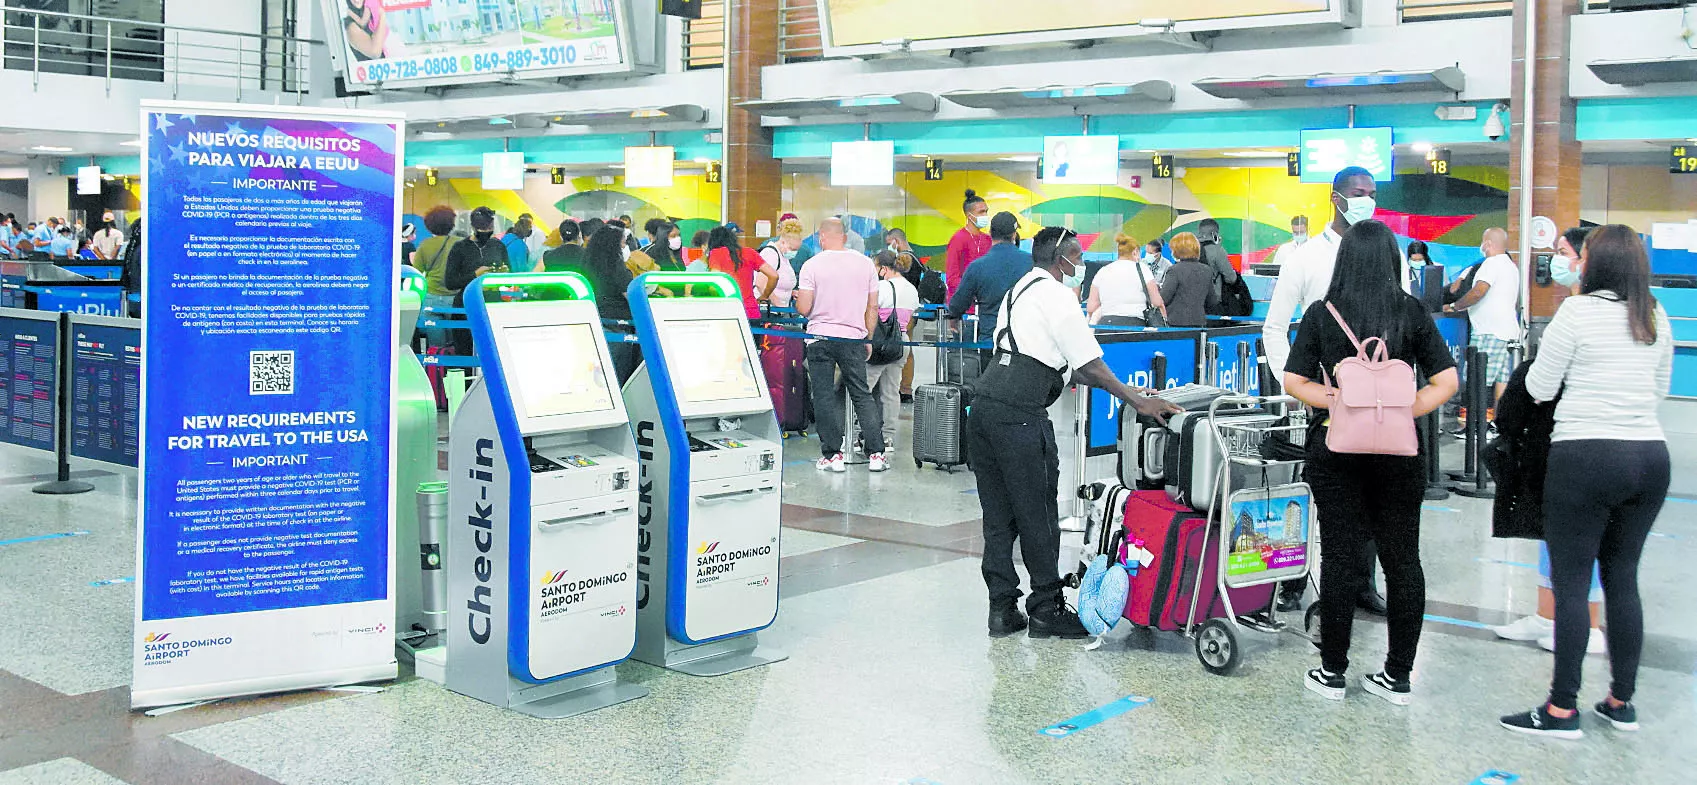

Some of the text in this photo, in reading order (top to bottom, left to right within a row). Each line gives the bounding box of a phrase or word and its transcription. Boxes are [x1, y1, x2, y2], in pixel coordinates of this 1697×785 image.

[368, 45, 576, 81] 809-728-0808 849-889-3010
[188, 132, 361, 152] NUEVOS REQUISITOS
[188, 151, 360, 171] PARA VIAJAR A EEUU
[1431, 160, 1447, 174] 18
[1679, 157, 1697, 172] 19
[929, 168, 940, 179] 14
[1157, 165, 1170, 177] 16
[1293, 163, 1299, 175] 1
[554, 174, 562, 184] 10
[709, 172, 719, 182] 12
[233, 178, 317, 191] IMPORTANTE
[183, 411, 356, 430] NEW REQUIREMENTS
[168, 430, 369, 450] FOR TRAVEL TO THE USA
[232, 454, 308, 468] IMPORTANT
[186, 478, 222, 486] passengers
[237, 483, 261, 491] provide
[266, 481, 294, 489] negative
[175, 494, 206, 502] antigens)
[205, 492, 239, 500] performed
[261, 511, 294, 519] laboratory
[188, 539, 221, 547] passenger
[249, 535, 272, 543] provide
[273, 533, 300, 541] negative
[312, 529, 359, 537] documentation
[467, 437, 494, 645] Check-in
[697, 553, 728, 567] SANTO
[215, 589, 244, 597] available
[243, 588, 253, 596] by
[252, 586, 281, 595] scanning
[293, 584, 304, 592] QR
[541, 582, 577, 598] SANTO
[144, 642, 180, 653] SANTO
